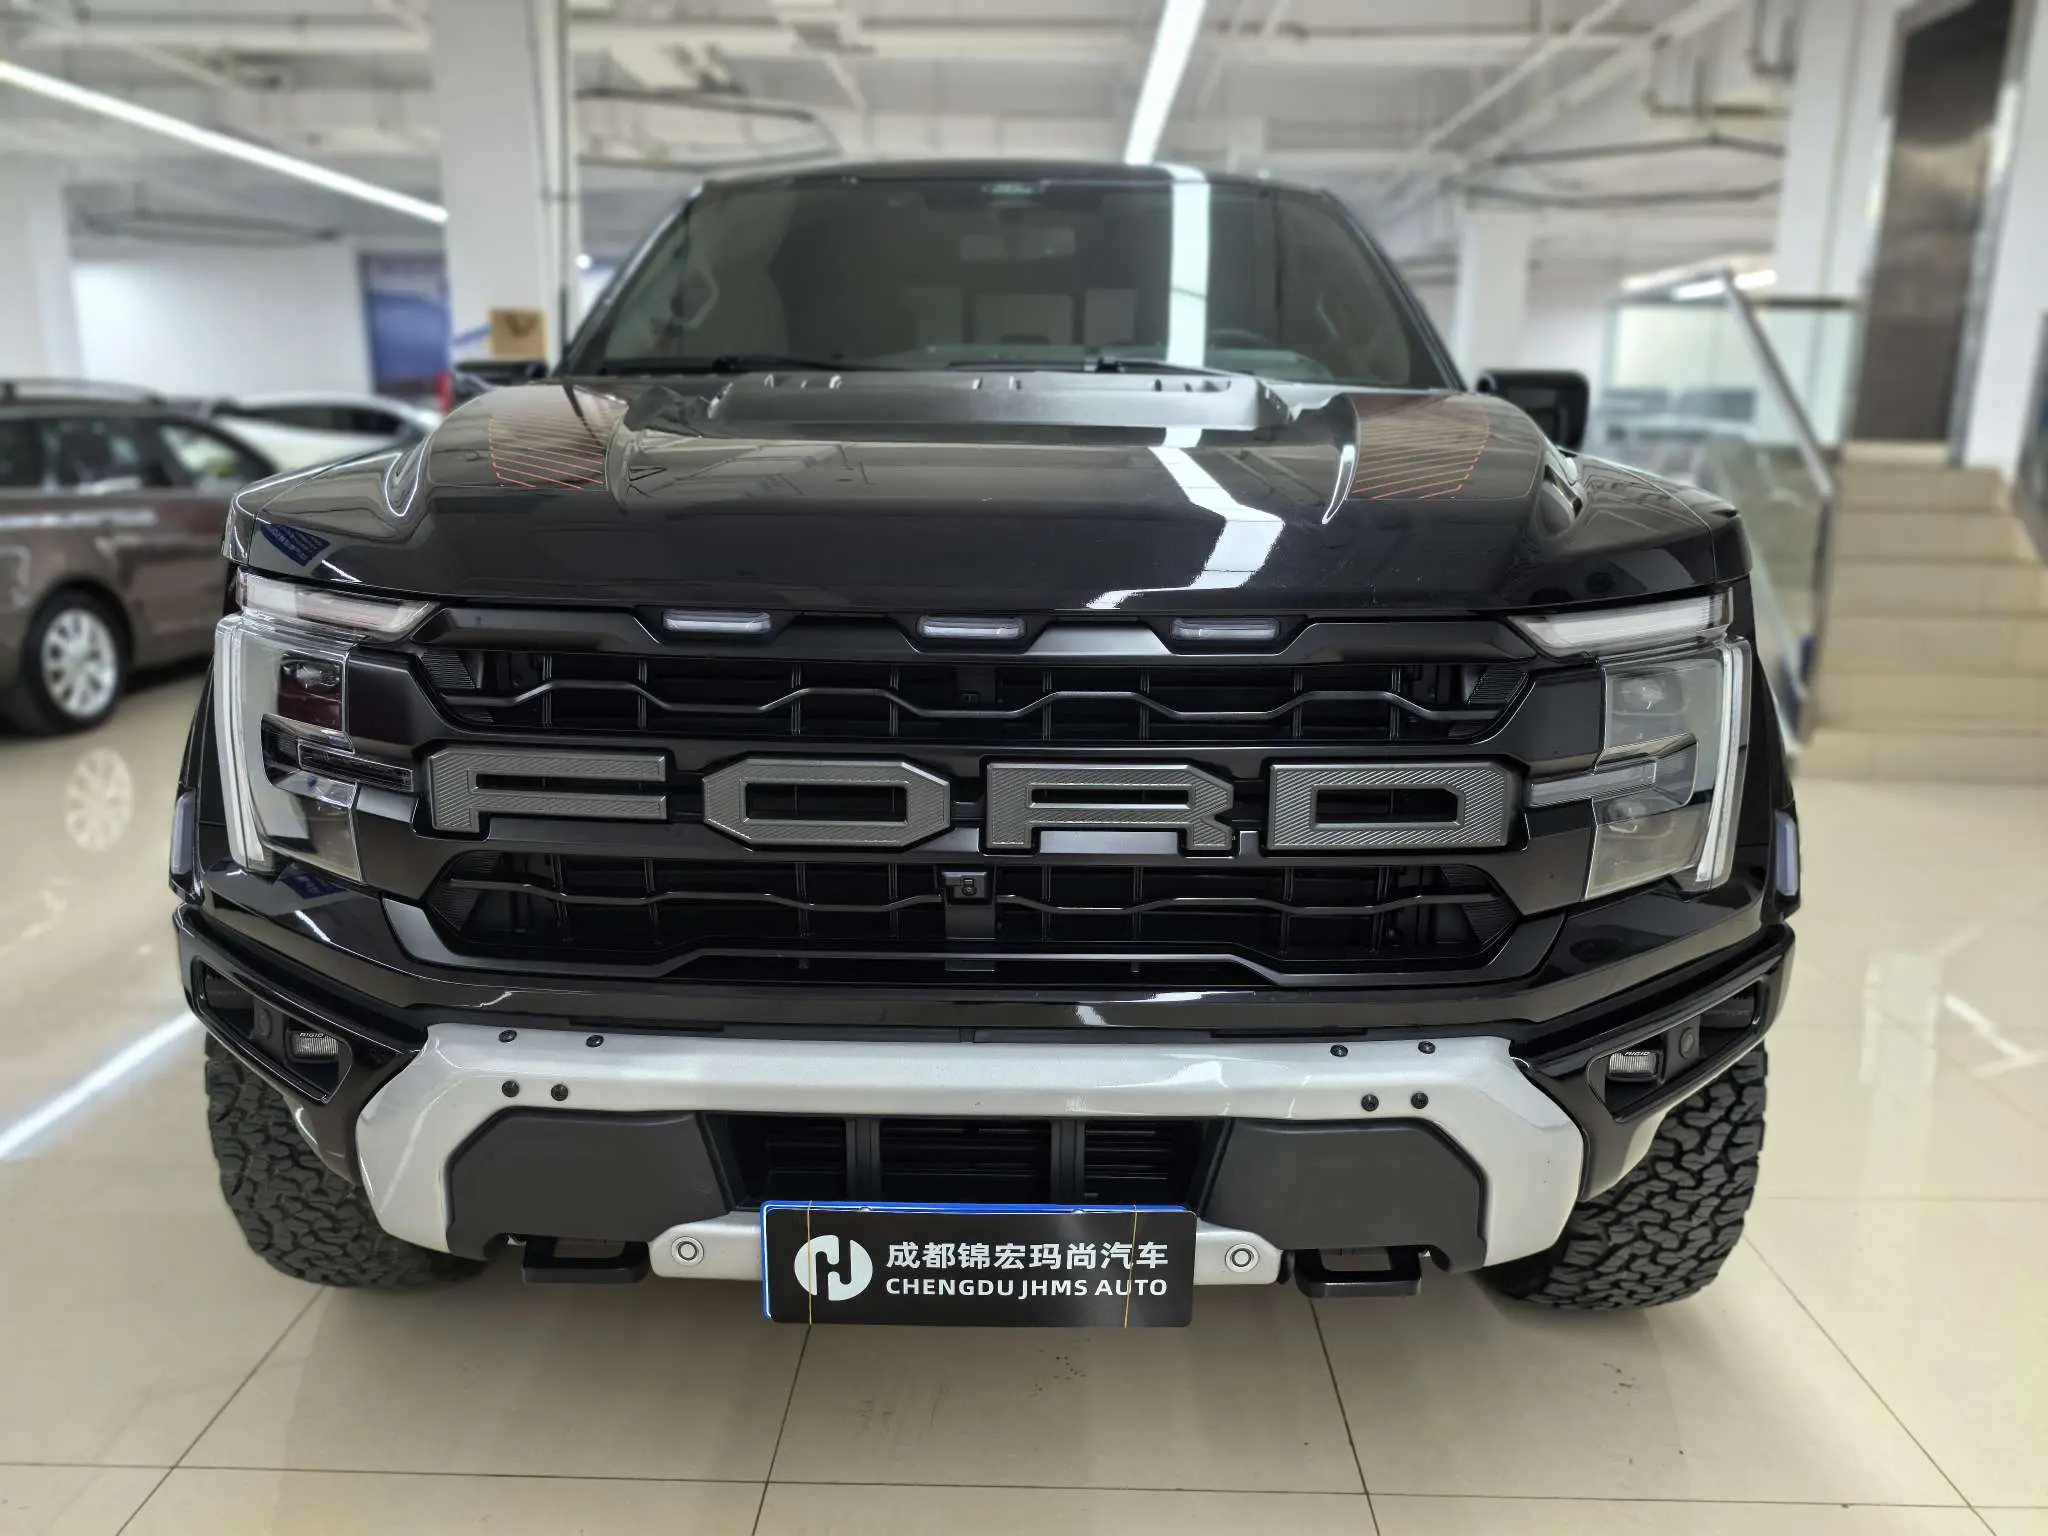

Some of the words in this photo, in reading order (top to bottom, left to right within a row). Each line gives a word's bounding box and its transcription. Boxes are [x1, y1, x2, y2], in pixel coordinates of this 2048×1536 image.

[428, 748, 1519, 850] FORD
[886, 1241, 1169, 1270] 成都锦宏玛尚汽车
[886, 1278, 1014, 1296] CHENGDU
[1018, 1279, 1088, 1299] JHMS
[1095, 1279, 1168, 1296] AUTO
